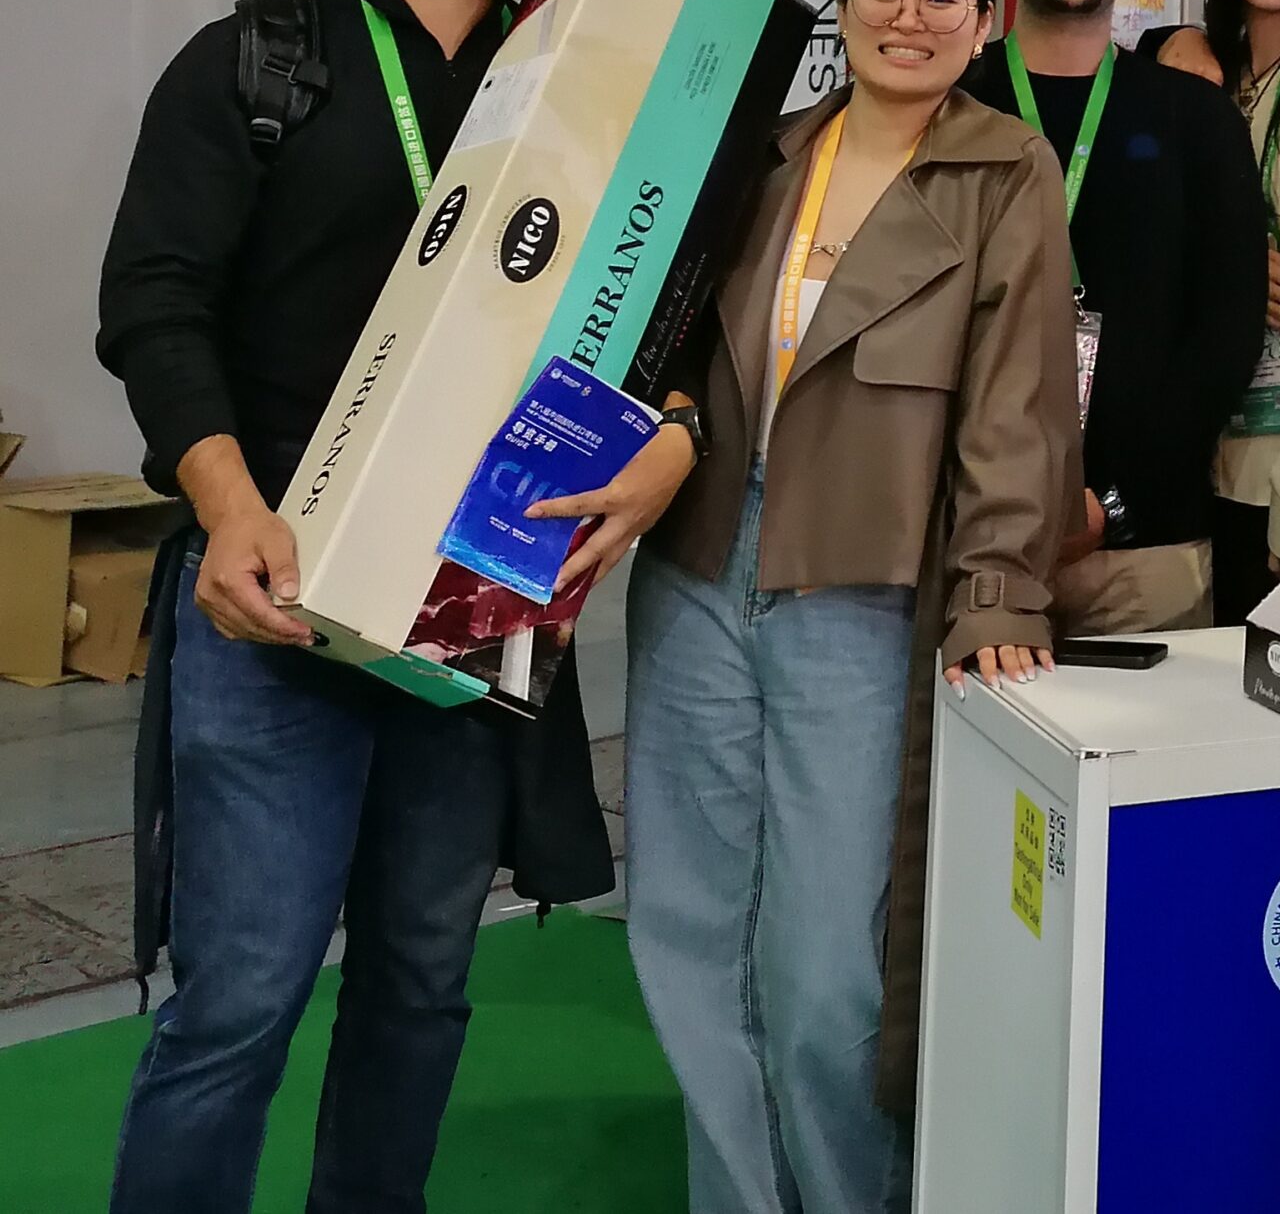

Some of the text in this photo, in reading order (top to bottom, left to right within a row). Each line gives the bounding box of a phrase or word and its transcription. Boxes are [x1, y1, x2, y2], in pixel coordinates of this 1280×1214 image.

[424, 194, 463, 258] NICO
[508, 206, 550, 276] NICO
[570, 180, 664, 373] ERRANOS
[301, 332, 397, 517] SERRANOS
